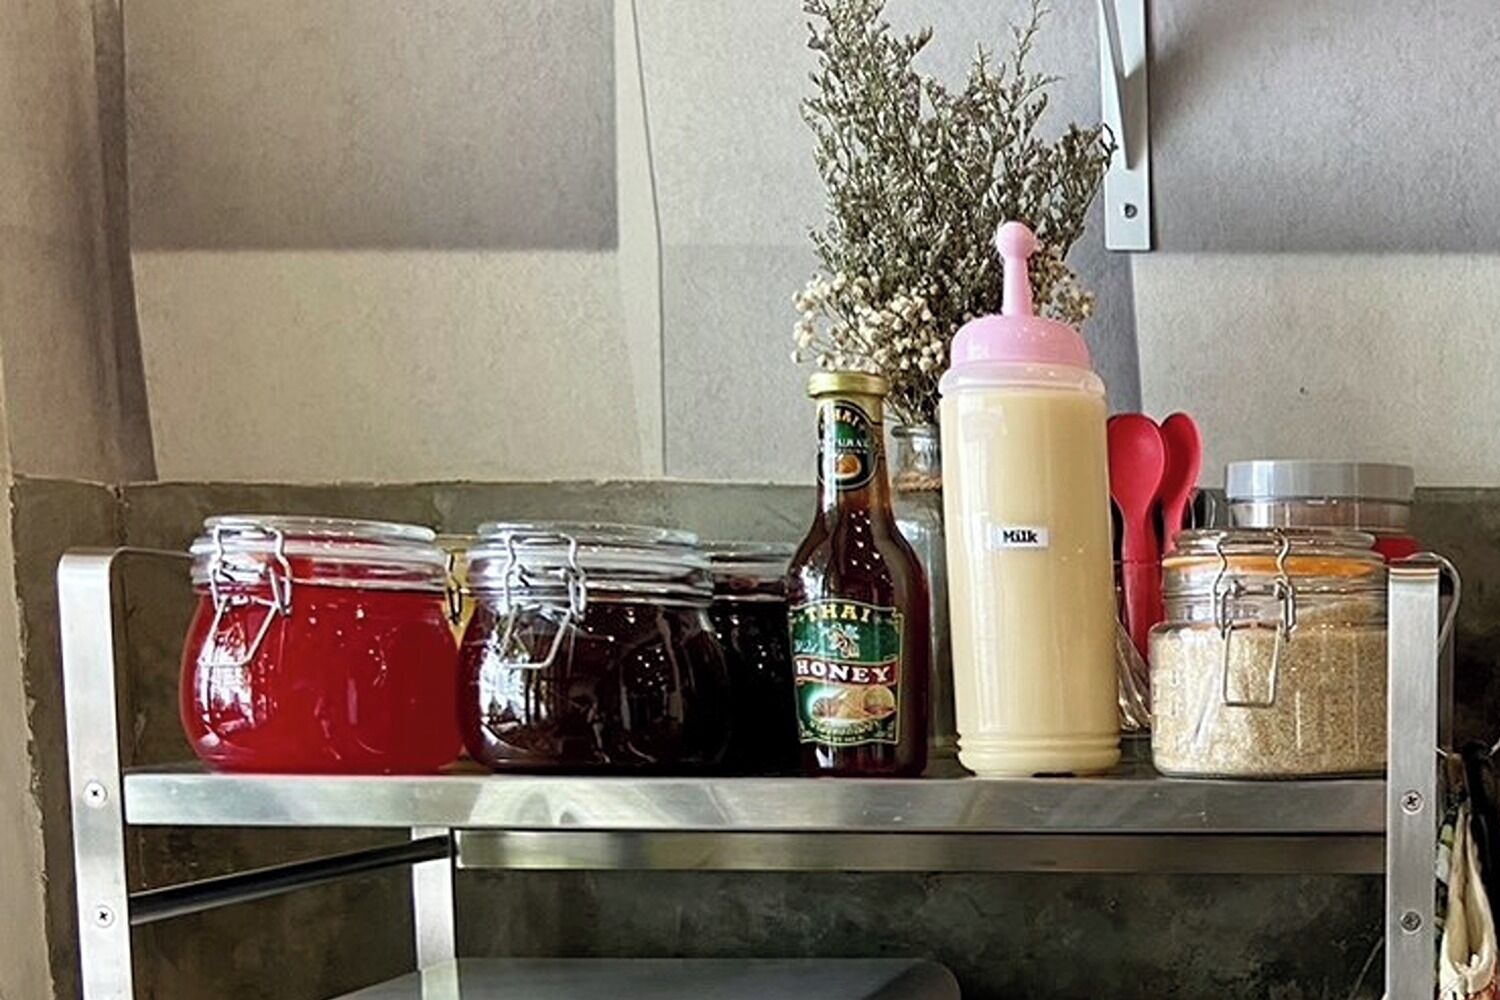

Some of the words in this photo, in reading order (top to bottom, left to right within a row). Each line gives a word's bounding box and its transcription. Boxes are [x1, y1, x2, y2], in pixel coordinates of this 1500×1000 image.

[1003, 529, 1039, 544] Milk
[804, 603, 872, 623] THAI
[795, 659, 891, 683] HONEY
